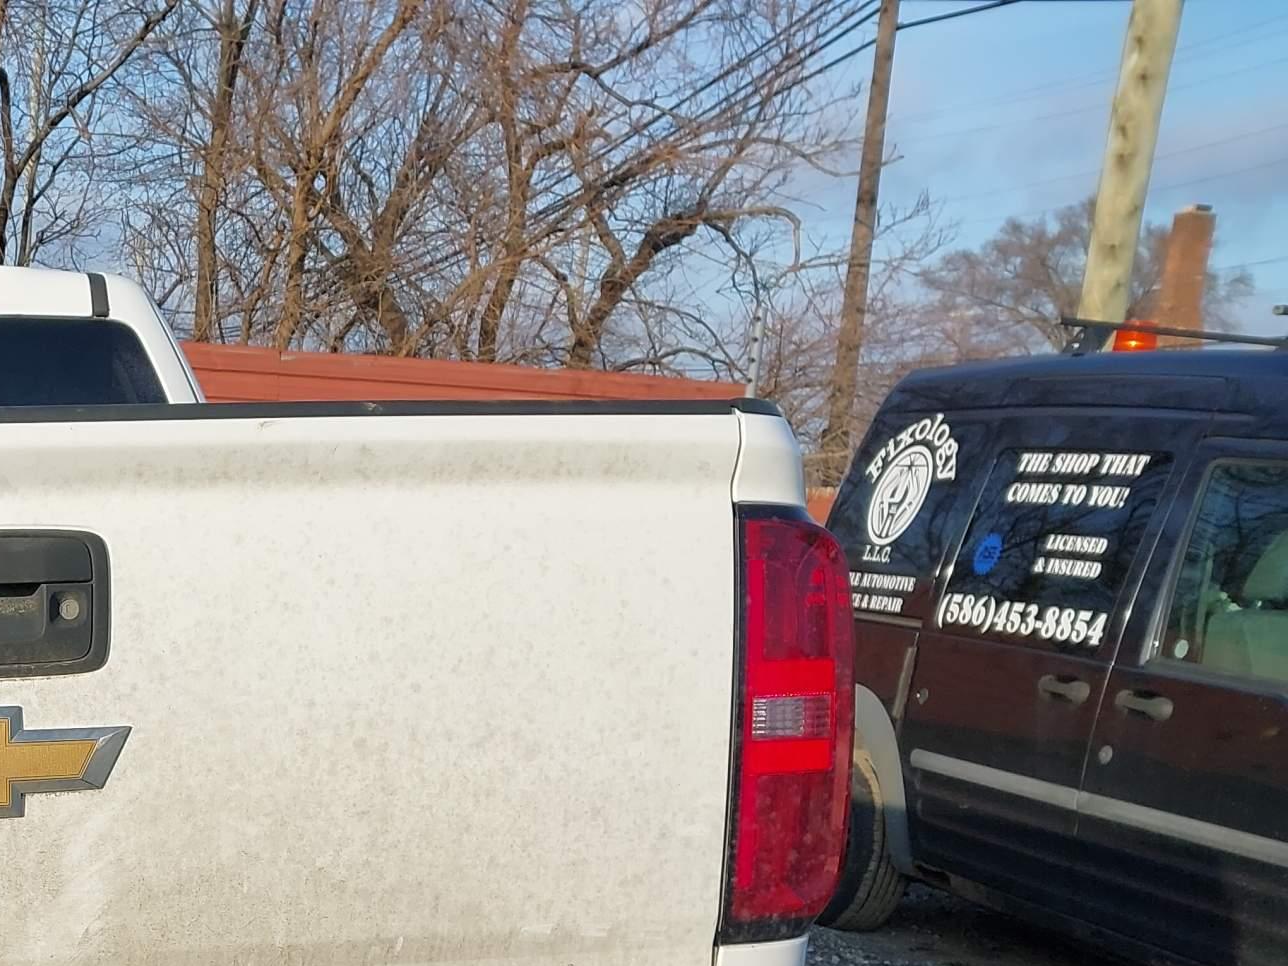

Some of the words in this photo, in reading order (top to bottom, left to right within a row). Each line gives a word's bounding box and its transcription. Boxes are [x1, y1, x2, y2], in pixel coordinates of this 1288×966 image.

[865, 412, 959, 484] Fixology
[1018, 452, 1053, 473] THE
[1052, 453, 1100, 475] SHOP
[1100, 453, 1151, 476] THAT
[1007, 482, 1062, 505] COMES
[1062, 484, 1088, 506] TO
[1087, 485, 1131, 509] YOU!
[1046, 533, 1108, 554] LICENSED
[1033, 556, 1045, 573] &
[1045, 558, 1103, 578] INSURED
[861, 573, 916, 592] AUTOMOTIVE
[860, 593, 870, 609] &
[869, 595, 904, 613] REPAIR
[937, 593, 1108, 646] (586)453-8854
